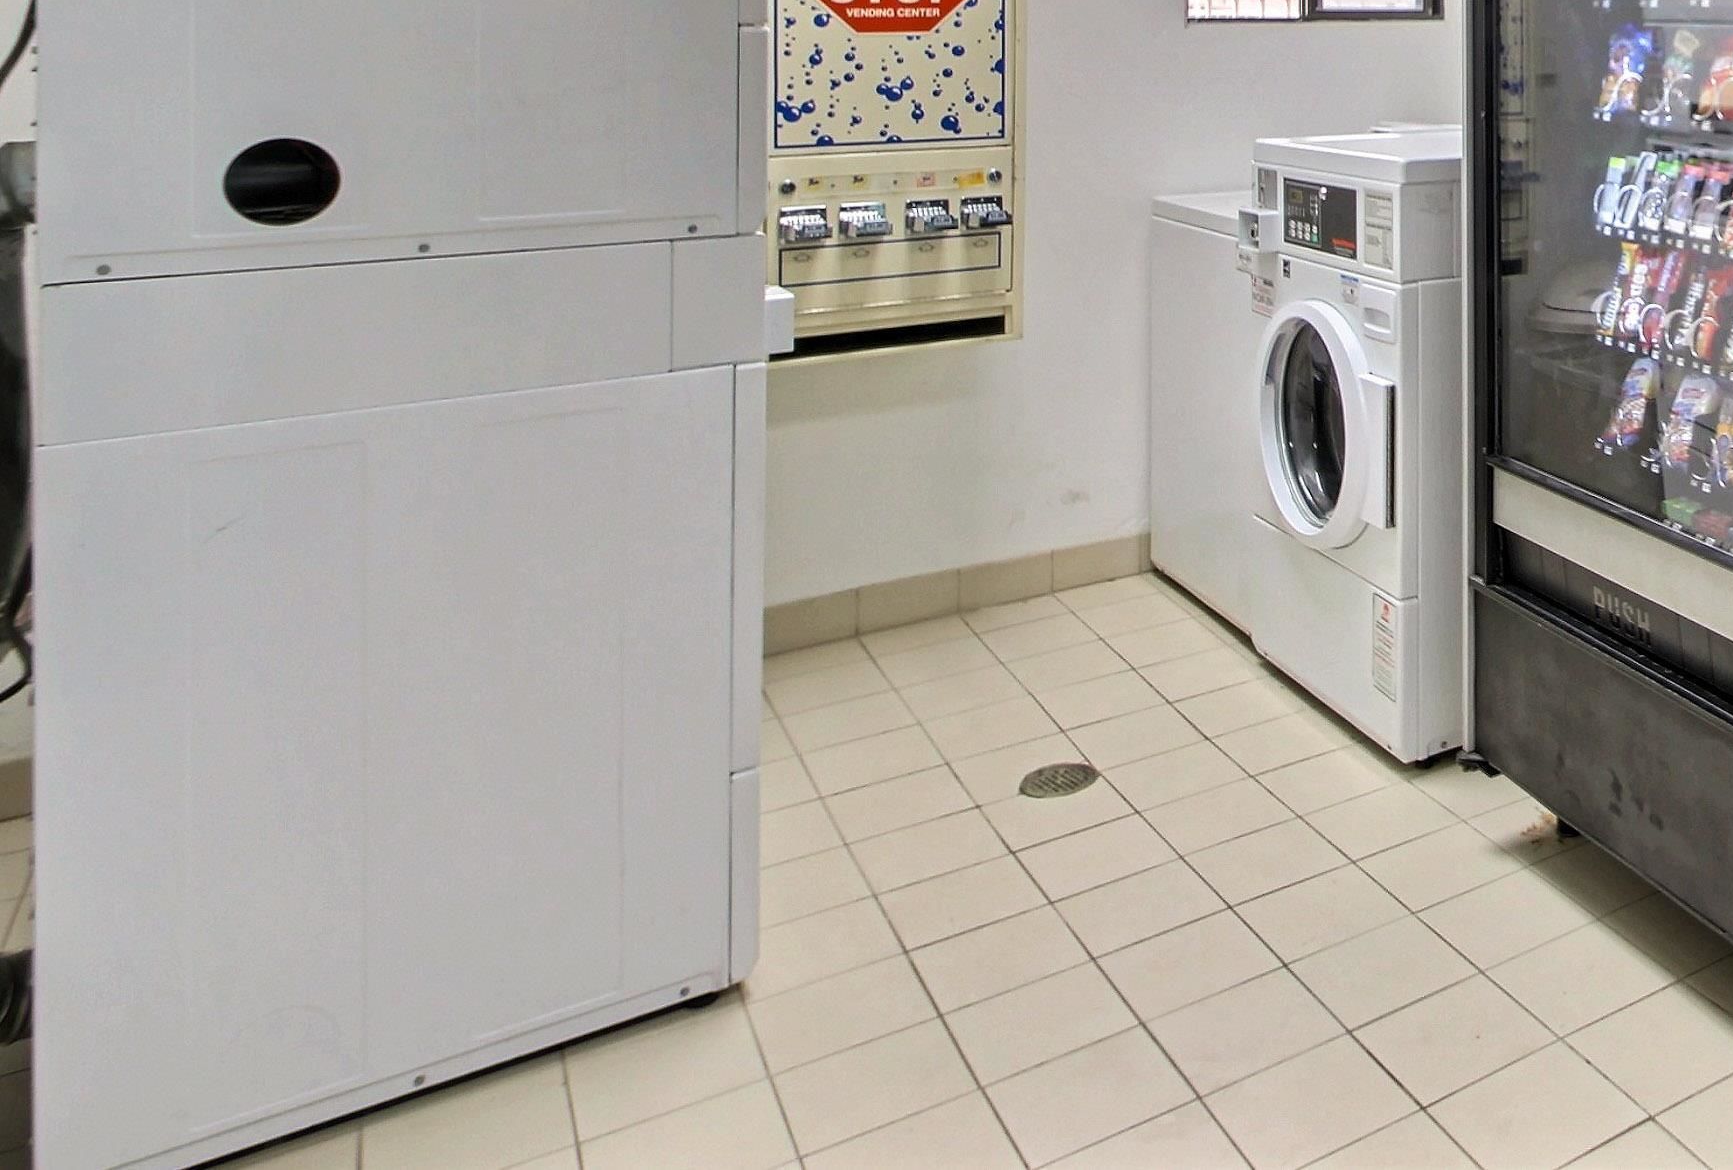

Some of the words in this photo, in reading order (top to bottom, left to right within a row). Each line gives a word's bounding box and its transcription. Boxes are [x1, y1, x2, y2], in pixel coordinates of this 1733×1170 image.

[846, 8, 895, 18] VENDING
[897, 8, 940, 18] CENTER
[1593, 586, 1652, 647] PUSH
